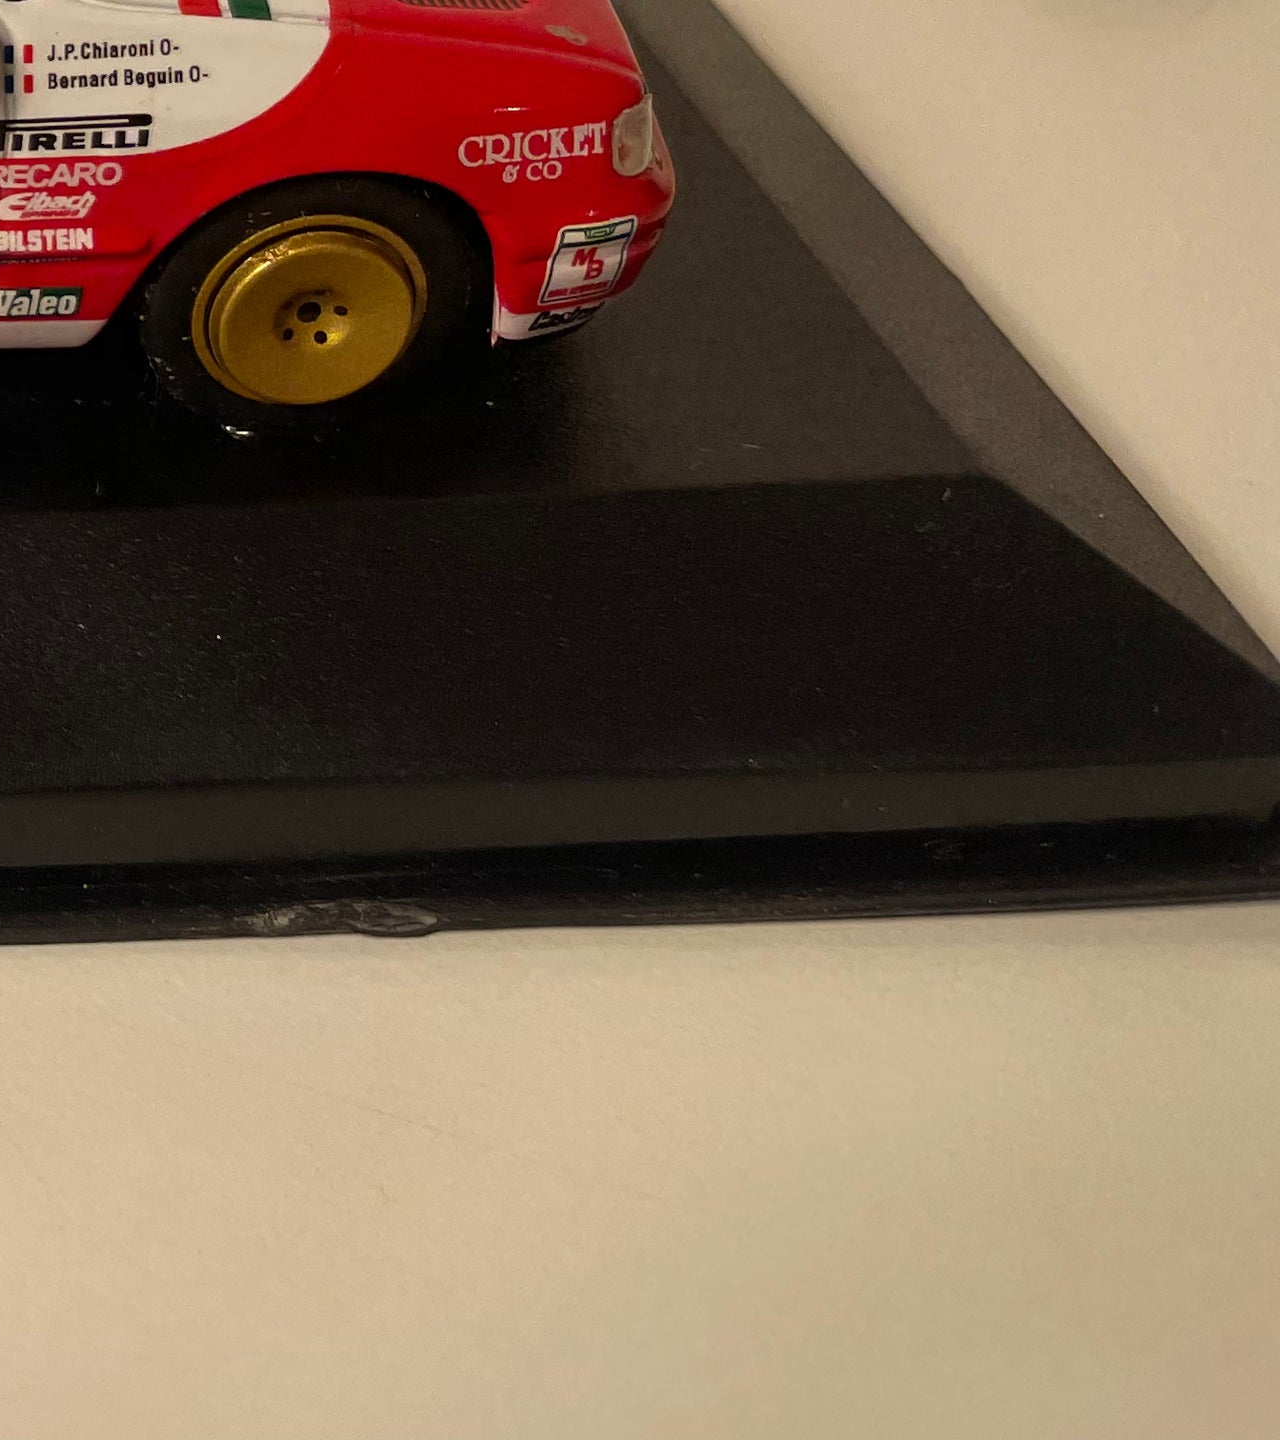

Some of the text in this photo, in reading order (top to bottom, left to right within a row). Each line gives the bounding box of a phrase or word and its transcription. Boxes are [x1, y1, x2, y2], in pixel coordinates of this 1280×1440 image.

[47, 70, 118, 90] Bernard
[124, 67, 184, 88] Beguin
[458, 120, 606, 167] CRICKET
[526, 161, 563, 181] CO
